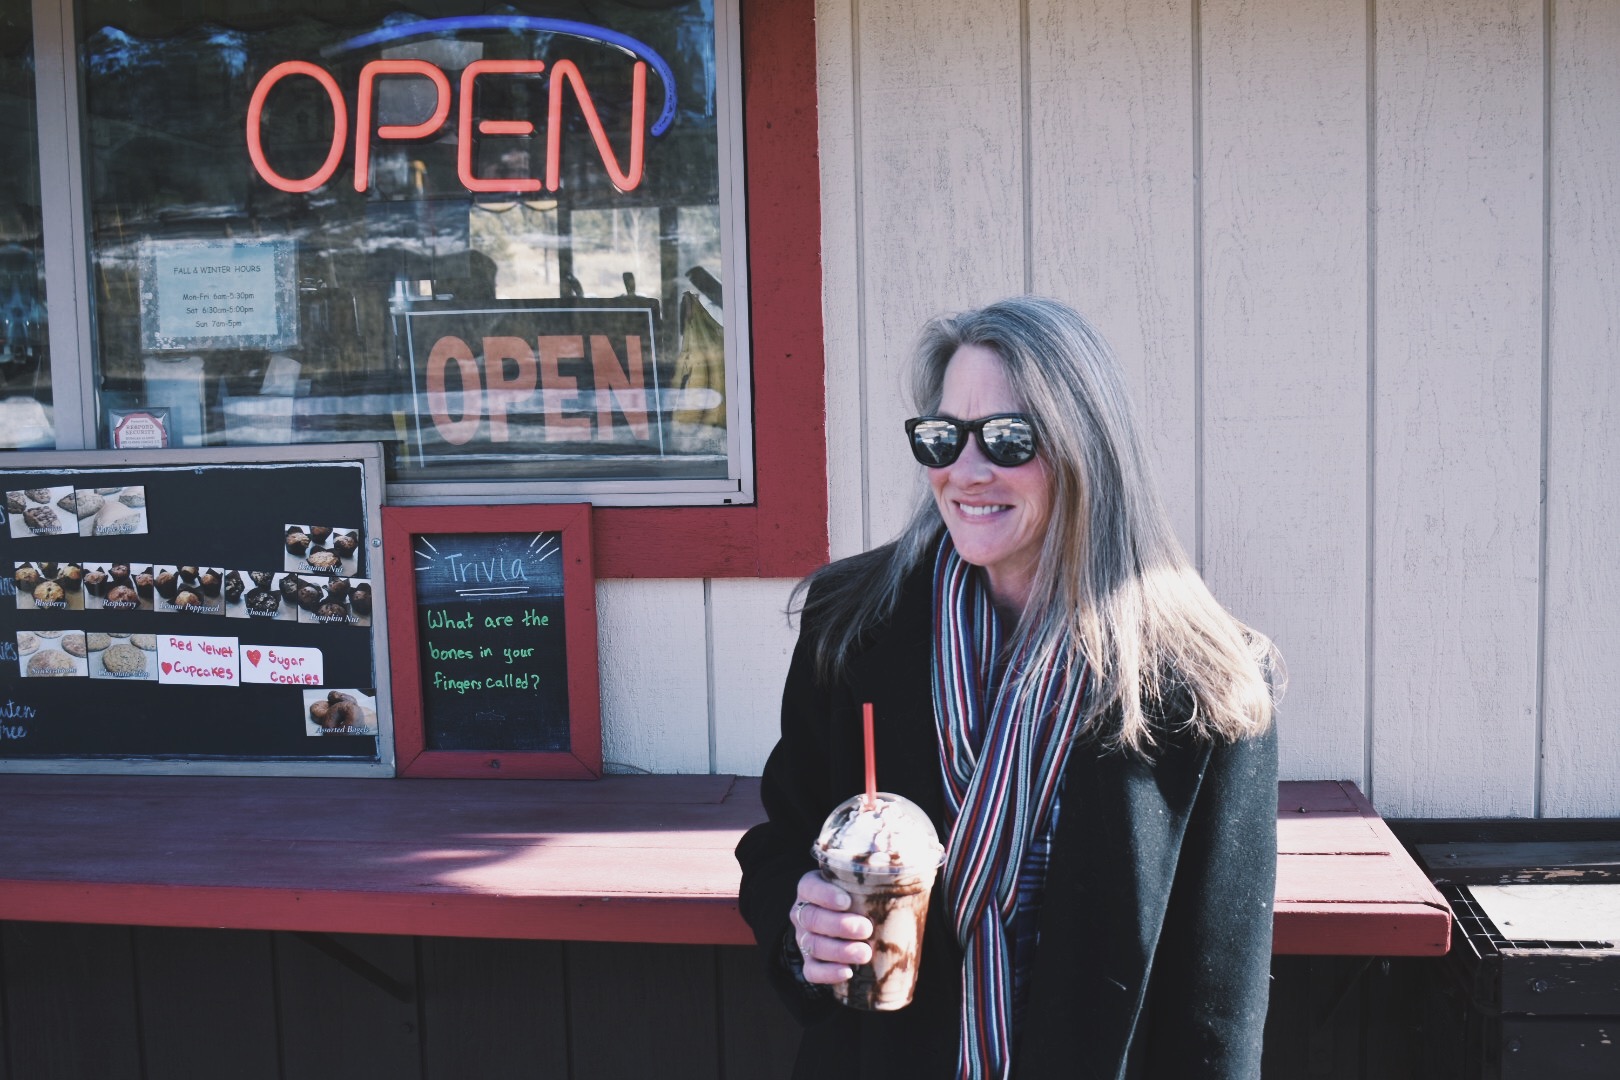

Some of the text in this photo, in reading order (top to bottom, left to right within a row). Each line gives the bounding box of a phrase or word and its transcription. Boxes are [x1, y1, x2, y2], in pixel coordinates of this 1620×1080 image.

[246, 59, 647, 193] OPEN
[173, 265, 261, 275] FALL & WINTER HOURS
[182, 291, 254, 301] Mon-Fri 6am-5:30pm
[202, 305, 254, 314] 6:30am-5:00pm
[195, 320, 242, 329] Sun 7am-5pm
[426, 334, 650, 446] OPEN
[328, 564, 344, 573] Nut
[444, 553, 528, 583] Trivia
[34, 598, 68, 609] Blueberry
[102, 599, 137, 610] Raspberry
[159, 602, 220, 614] Lemon Poppyseed
[244, 607, 279, 617] Chocolate
[310, 612, 360, 623] Pumpkin Nut
[427, 608, 549, 629] What are the
[169, 637, 233, 658] Red Velvet
[428, 641, 535, 664] bones in your
[268, 650, 305, 671] Sugar
[173, 661, 234, 680] Cupcakes
[270, 671, 320, 685] Cookies
[433, 671, 540, 696] fingers called?
[0, 699, 36, 719] uten
[316, 724, 370, 735] Assorted Bagels
